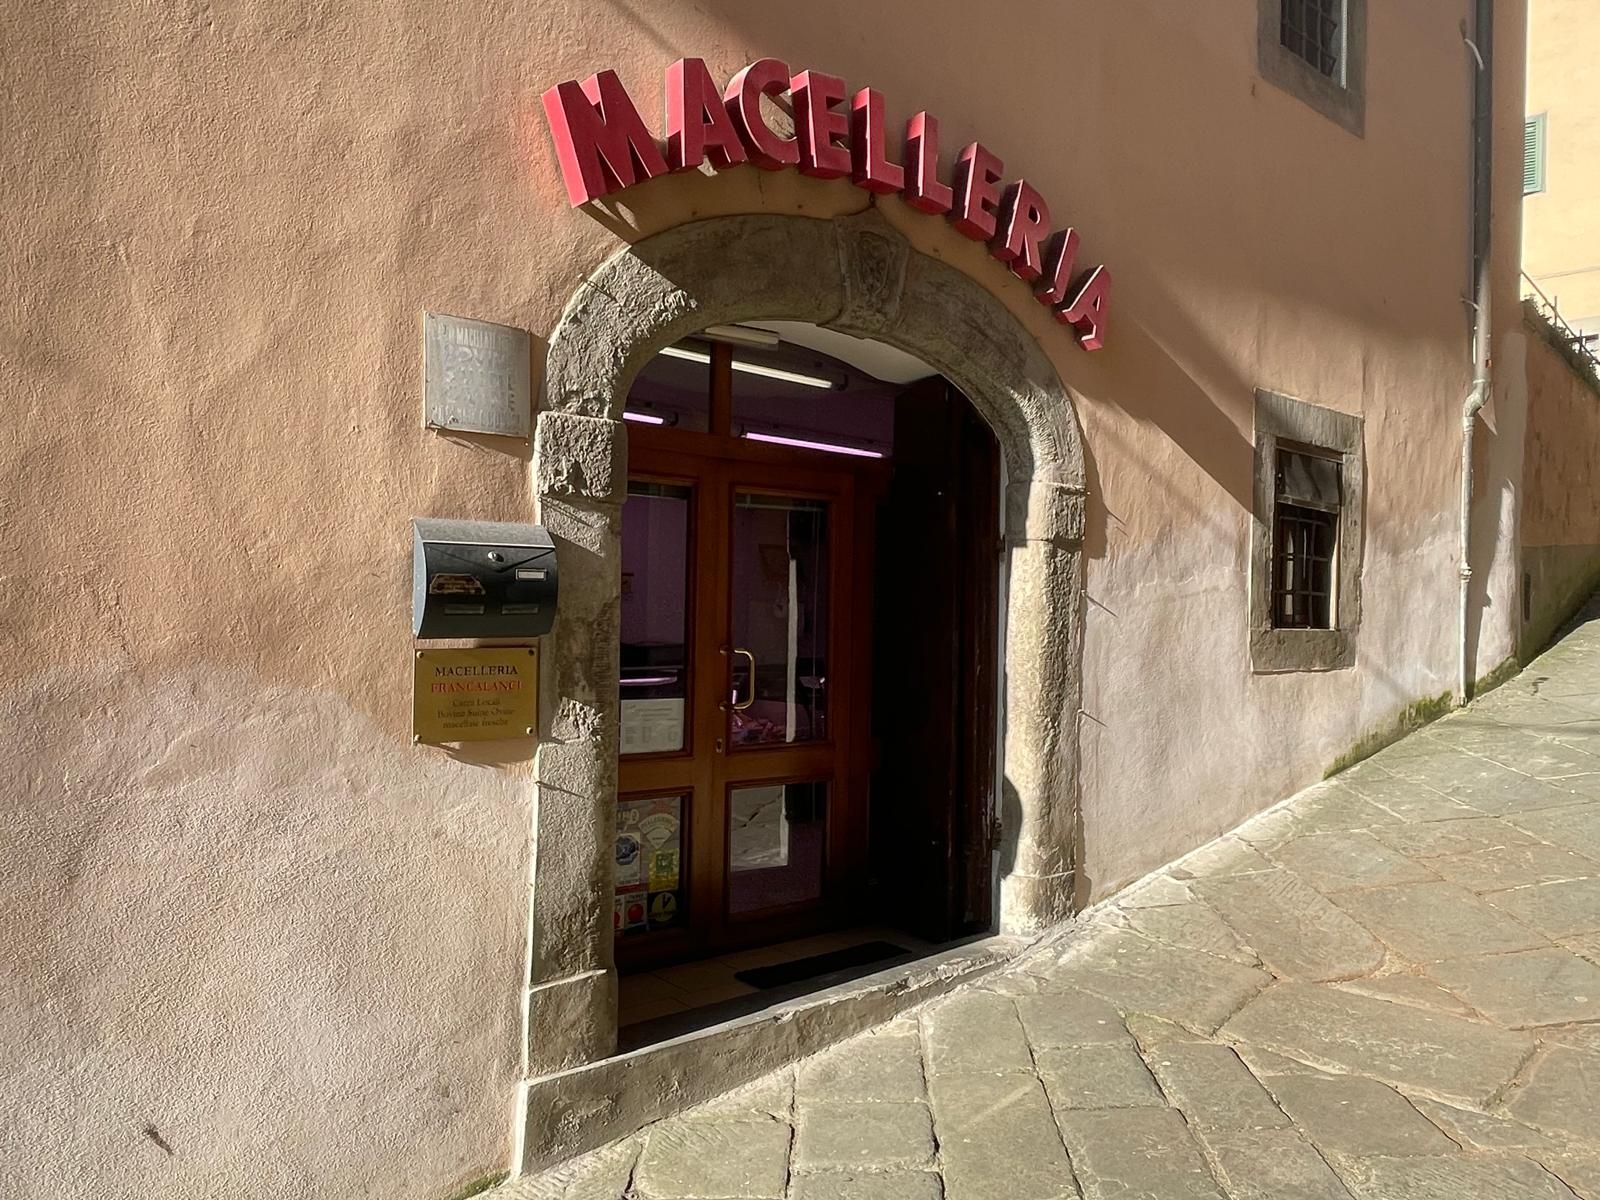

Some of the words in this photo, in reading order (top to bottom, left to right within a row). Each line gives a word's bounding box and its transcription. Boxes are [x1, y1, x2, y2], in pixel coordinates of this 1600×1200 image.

[541, 58, 1112, 351] MACELLERIA
[435, 666, 518, 677] MACELLERIA
[431, 680, 522, 693] FRANCALANCI
